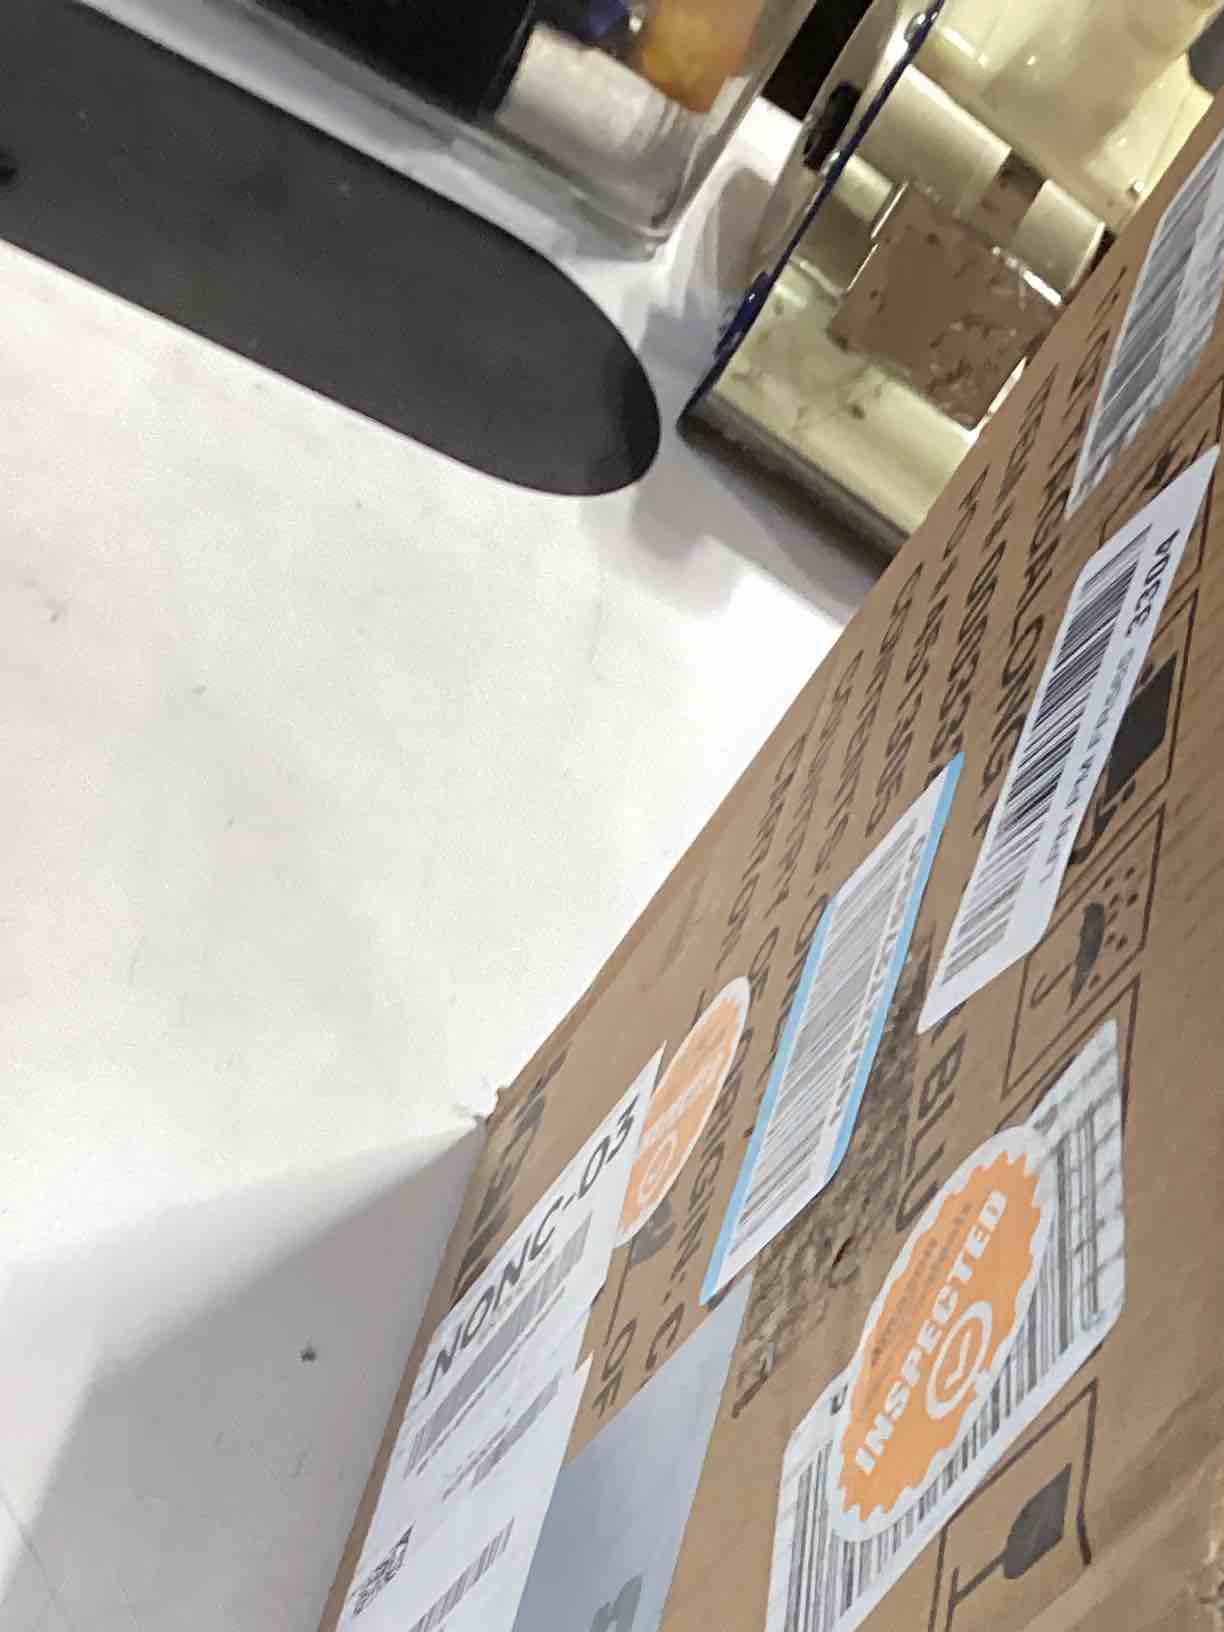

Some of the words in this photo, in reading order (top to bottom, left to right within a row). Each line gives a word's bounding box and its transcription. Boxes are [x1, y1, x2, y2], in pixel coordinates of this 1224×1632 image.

[1126, 529, 1179, 638] 3304
[423, 1093, 640, 1398] NONC-03
[855, 1190, 1007, 1474] INSPECTED
